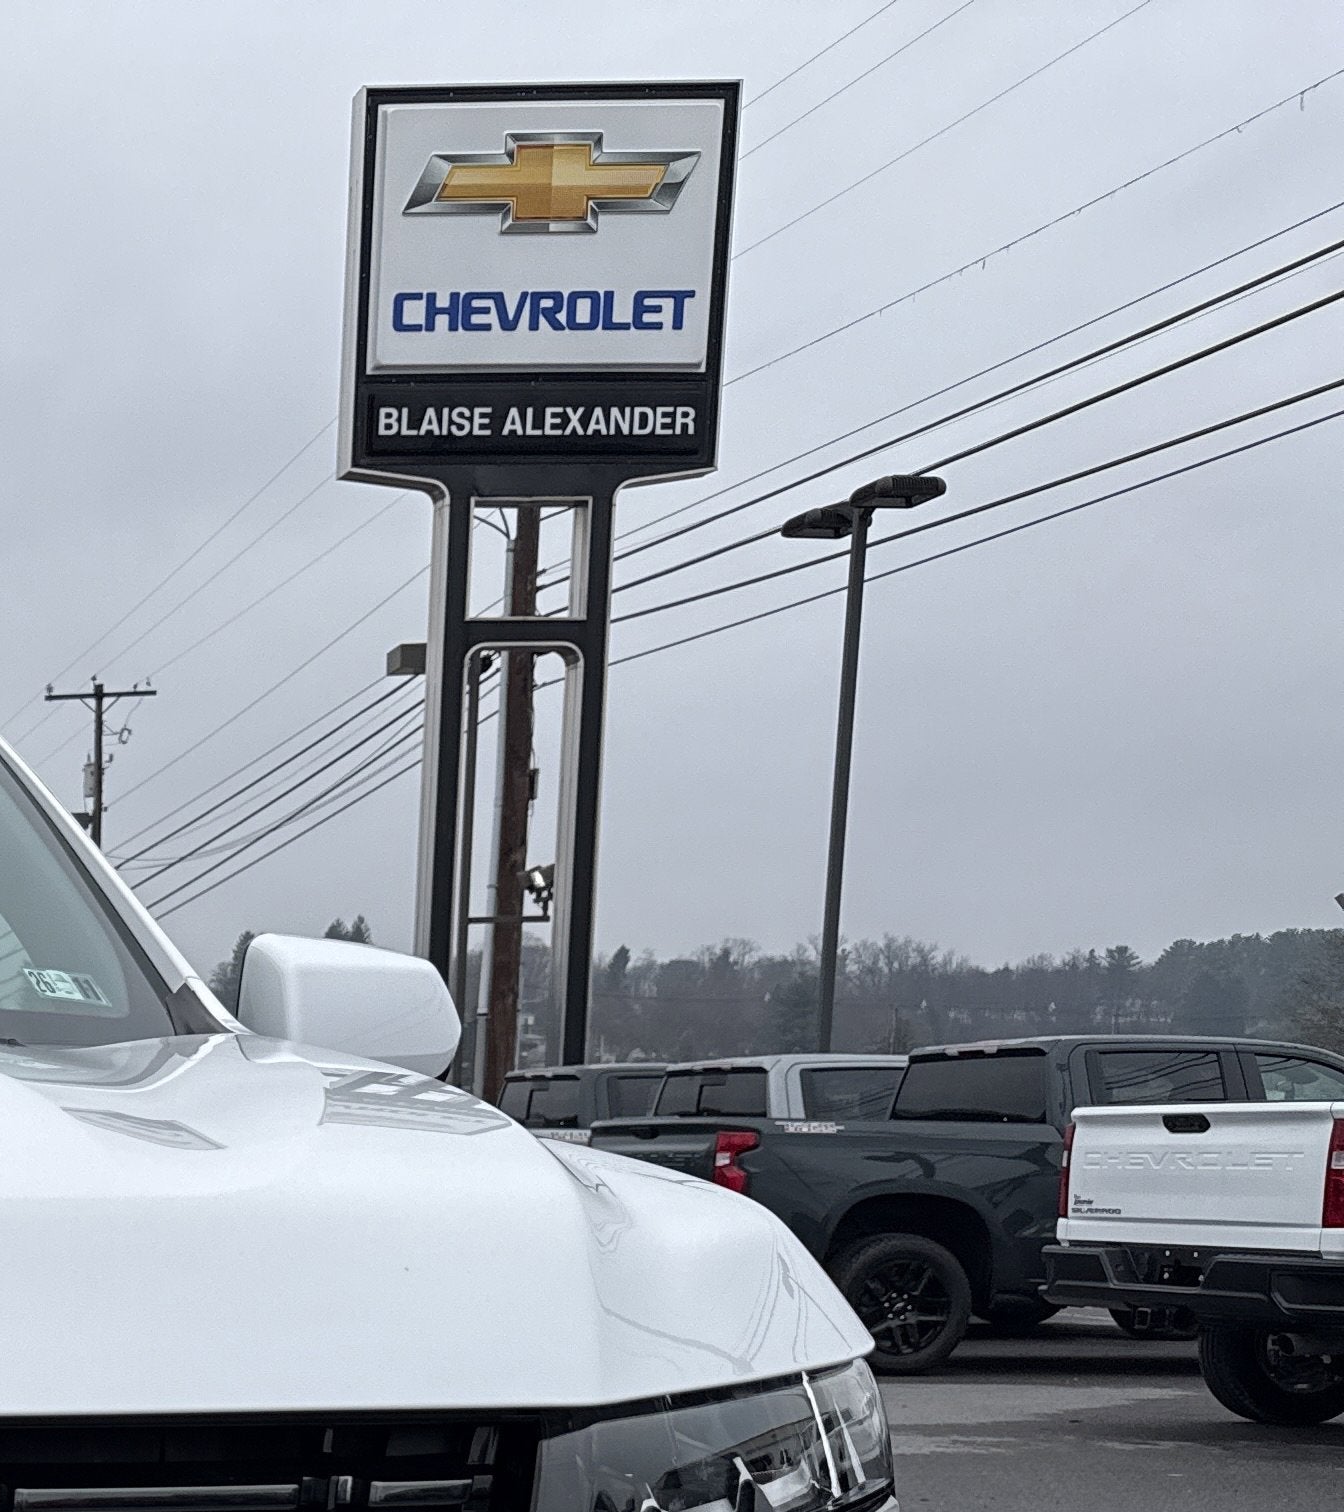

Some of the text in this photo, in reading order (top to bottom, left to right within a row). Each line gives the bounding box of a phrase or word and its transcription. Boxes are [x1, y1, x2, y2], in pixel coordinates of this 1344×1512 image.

[392, 289, 696, 332] CHEVROLET
[377, 405, 696, 437] BLAISE ALEXANDER
[27, 970, 57, 994] 26
[1082, 1151, 1305, 1171] CHEVROLET
